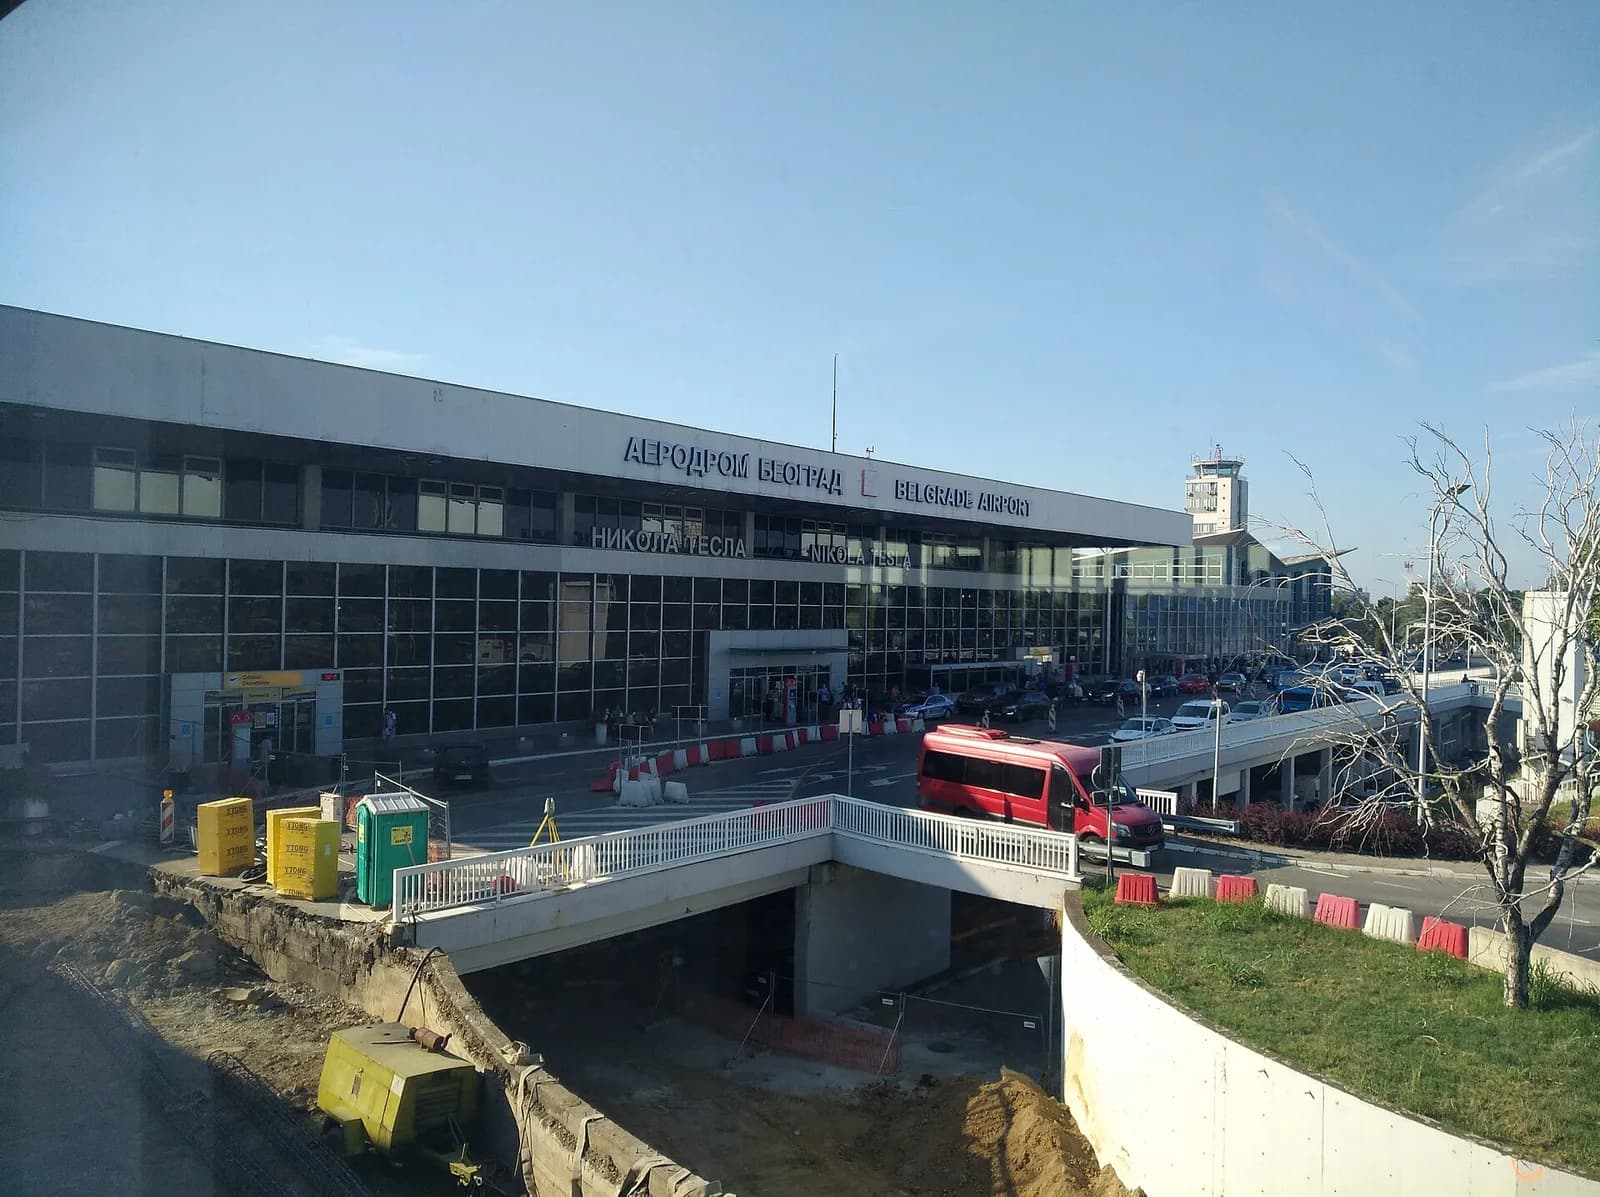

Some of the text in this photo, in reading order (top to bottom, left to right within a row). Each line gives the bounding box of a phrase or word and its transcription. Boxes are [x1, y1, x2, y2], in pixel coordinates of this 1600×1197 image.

[624, 436, 843, 496] АЕРОДРОМ БЕОГРАД
[895, 479, 1032, 517] BELGRADE AIRPORT
[592, 527, 746, 558] НИКОЛА ТЕСЛА
[810, 544, 913, 569] NIKOLA TESLA
